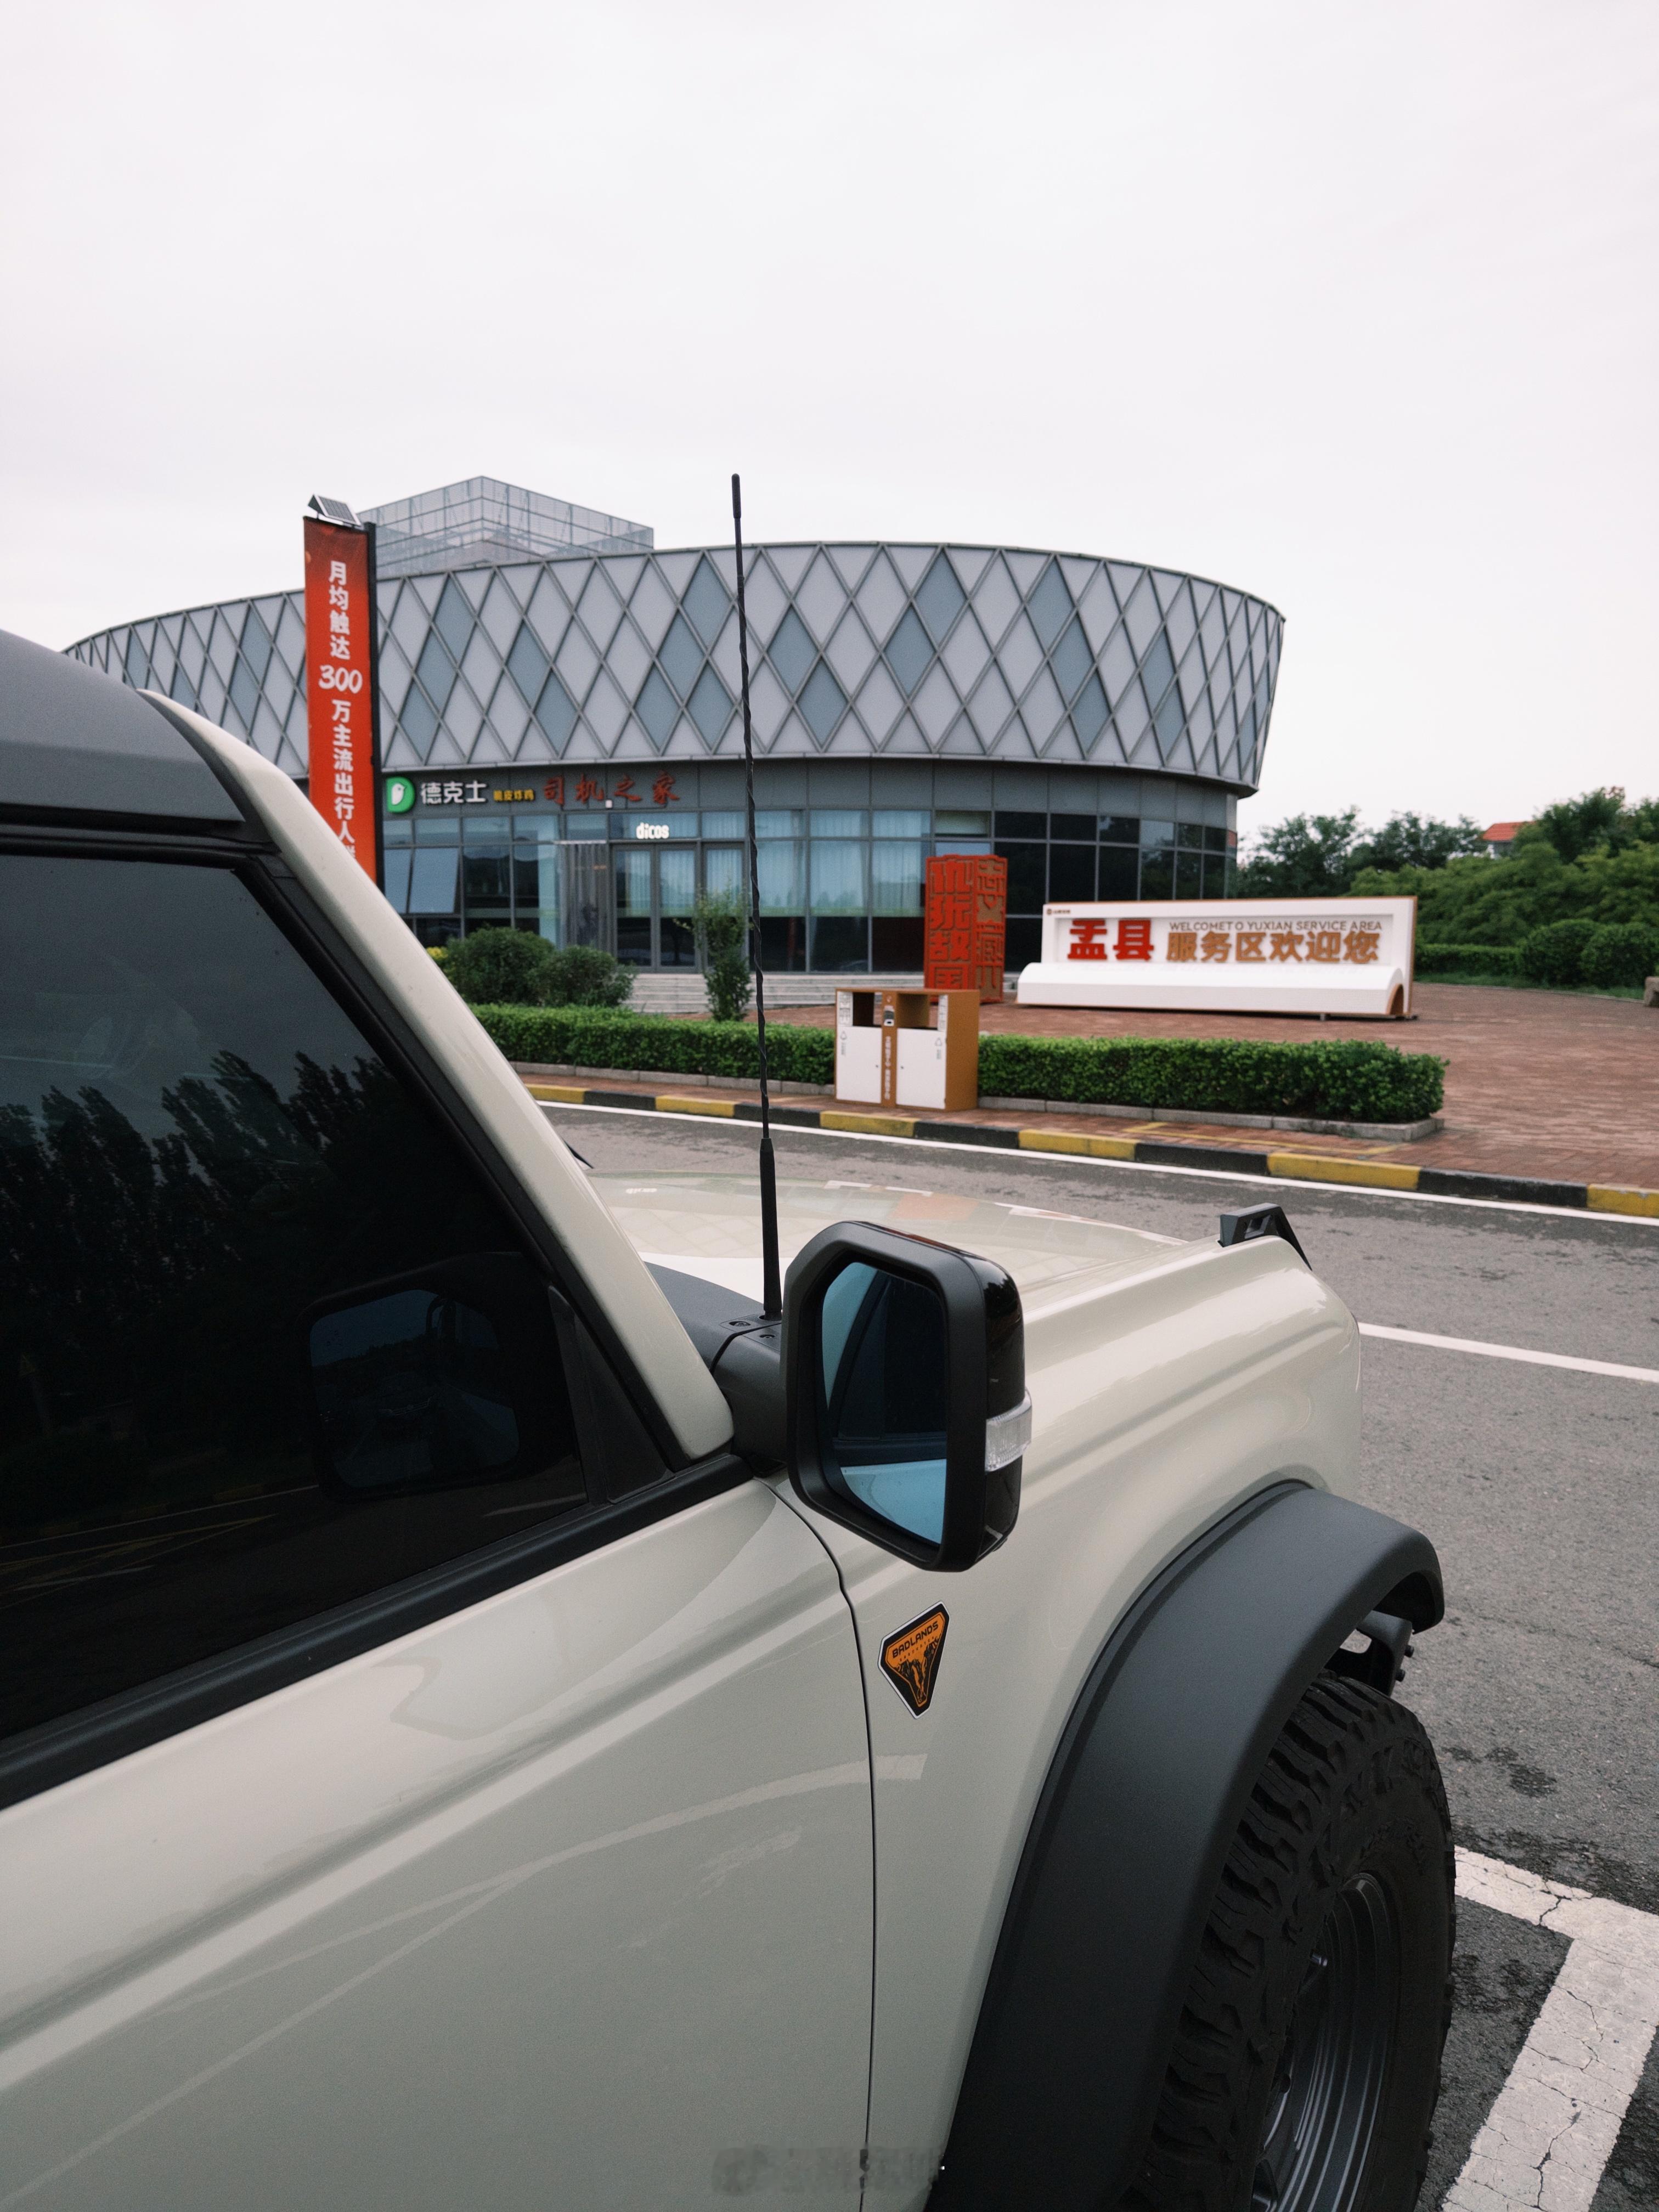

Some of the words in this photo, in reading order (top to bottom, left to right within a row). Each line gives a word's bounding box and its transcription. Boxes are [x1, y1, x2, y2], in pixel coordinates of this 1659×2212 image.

[318, 560, 363, 858] 月均触达300万主流出行人
[421, 780, 487, 804] 德克士
[543, 771, 680, 805] 司机之家
[636, 822, 669, 840] dicos
[1068, 918, 1154, 962] 盂县
[1166, 930, 1380, 964] 服务区欢迎您
[1247, 921, 1293, 930] YUXIAN
[1296, 920, 1347, 930] SERVICE
[1350, 920, 1383, 930] AREA
[892, 1621, 939, 1659] BADLANDS
